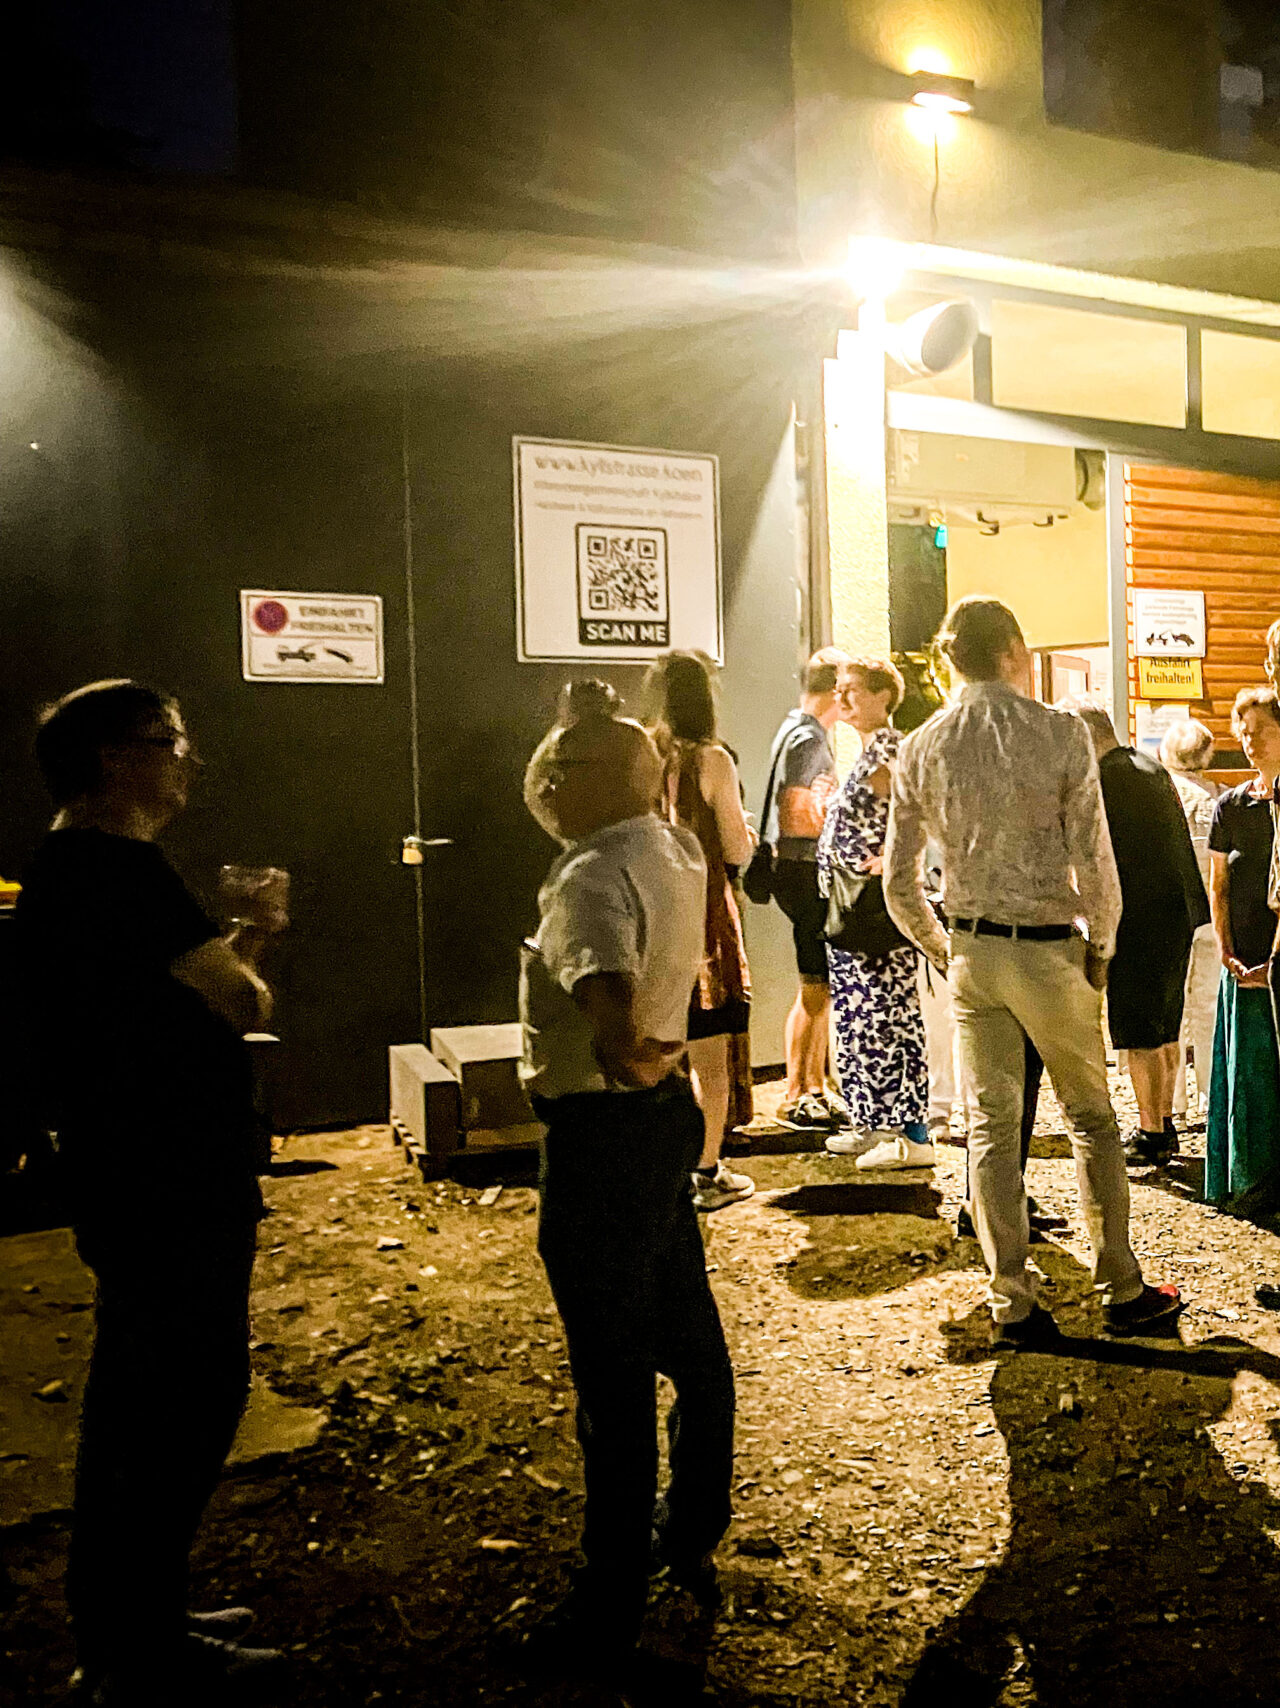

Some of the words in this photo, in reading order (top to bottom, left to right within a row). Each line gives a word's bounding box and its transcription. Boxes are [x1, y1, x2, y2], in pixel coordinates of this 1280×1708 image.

[586, 623, 636, 640] SCAN
[640, 624, 666, 642] ME
[1146, 671, 1194, 685] freihalten!
